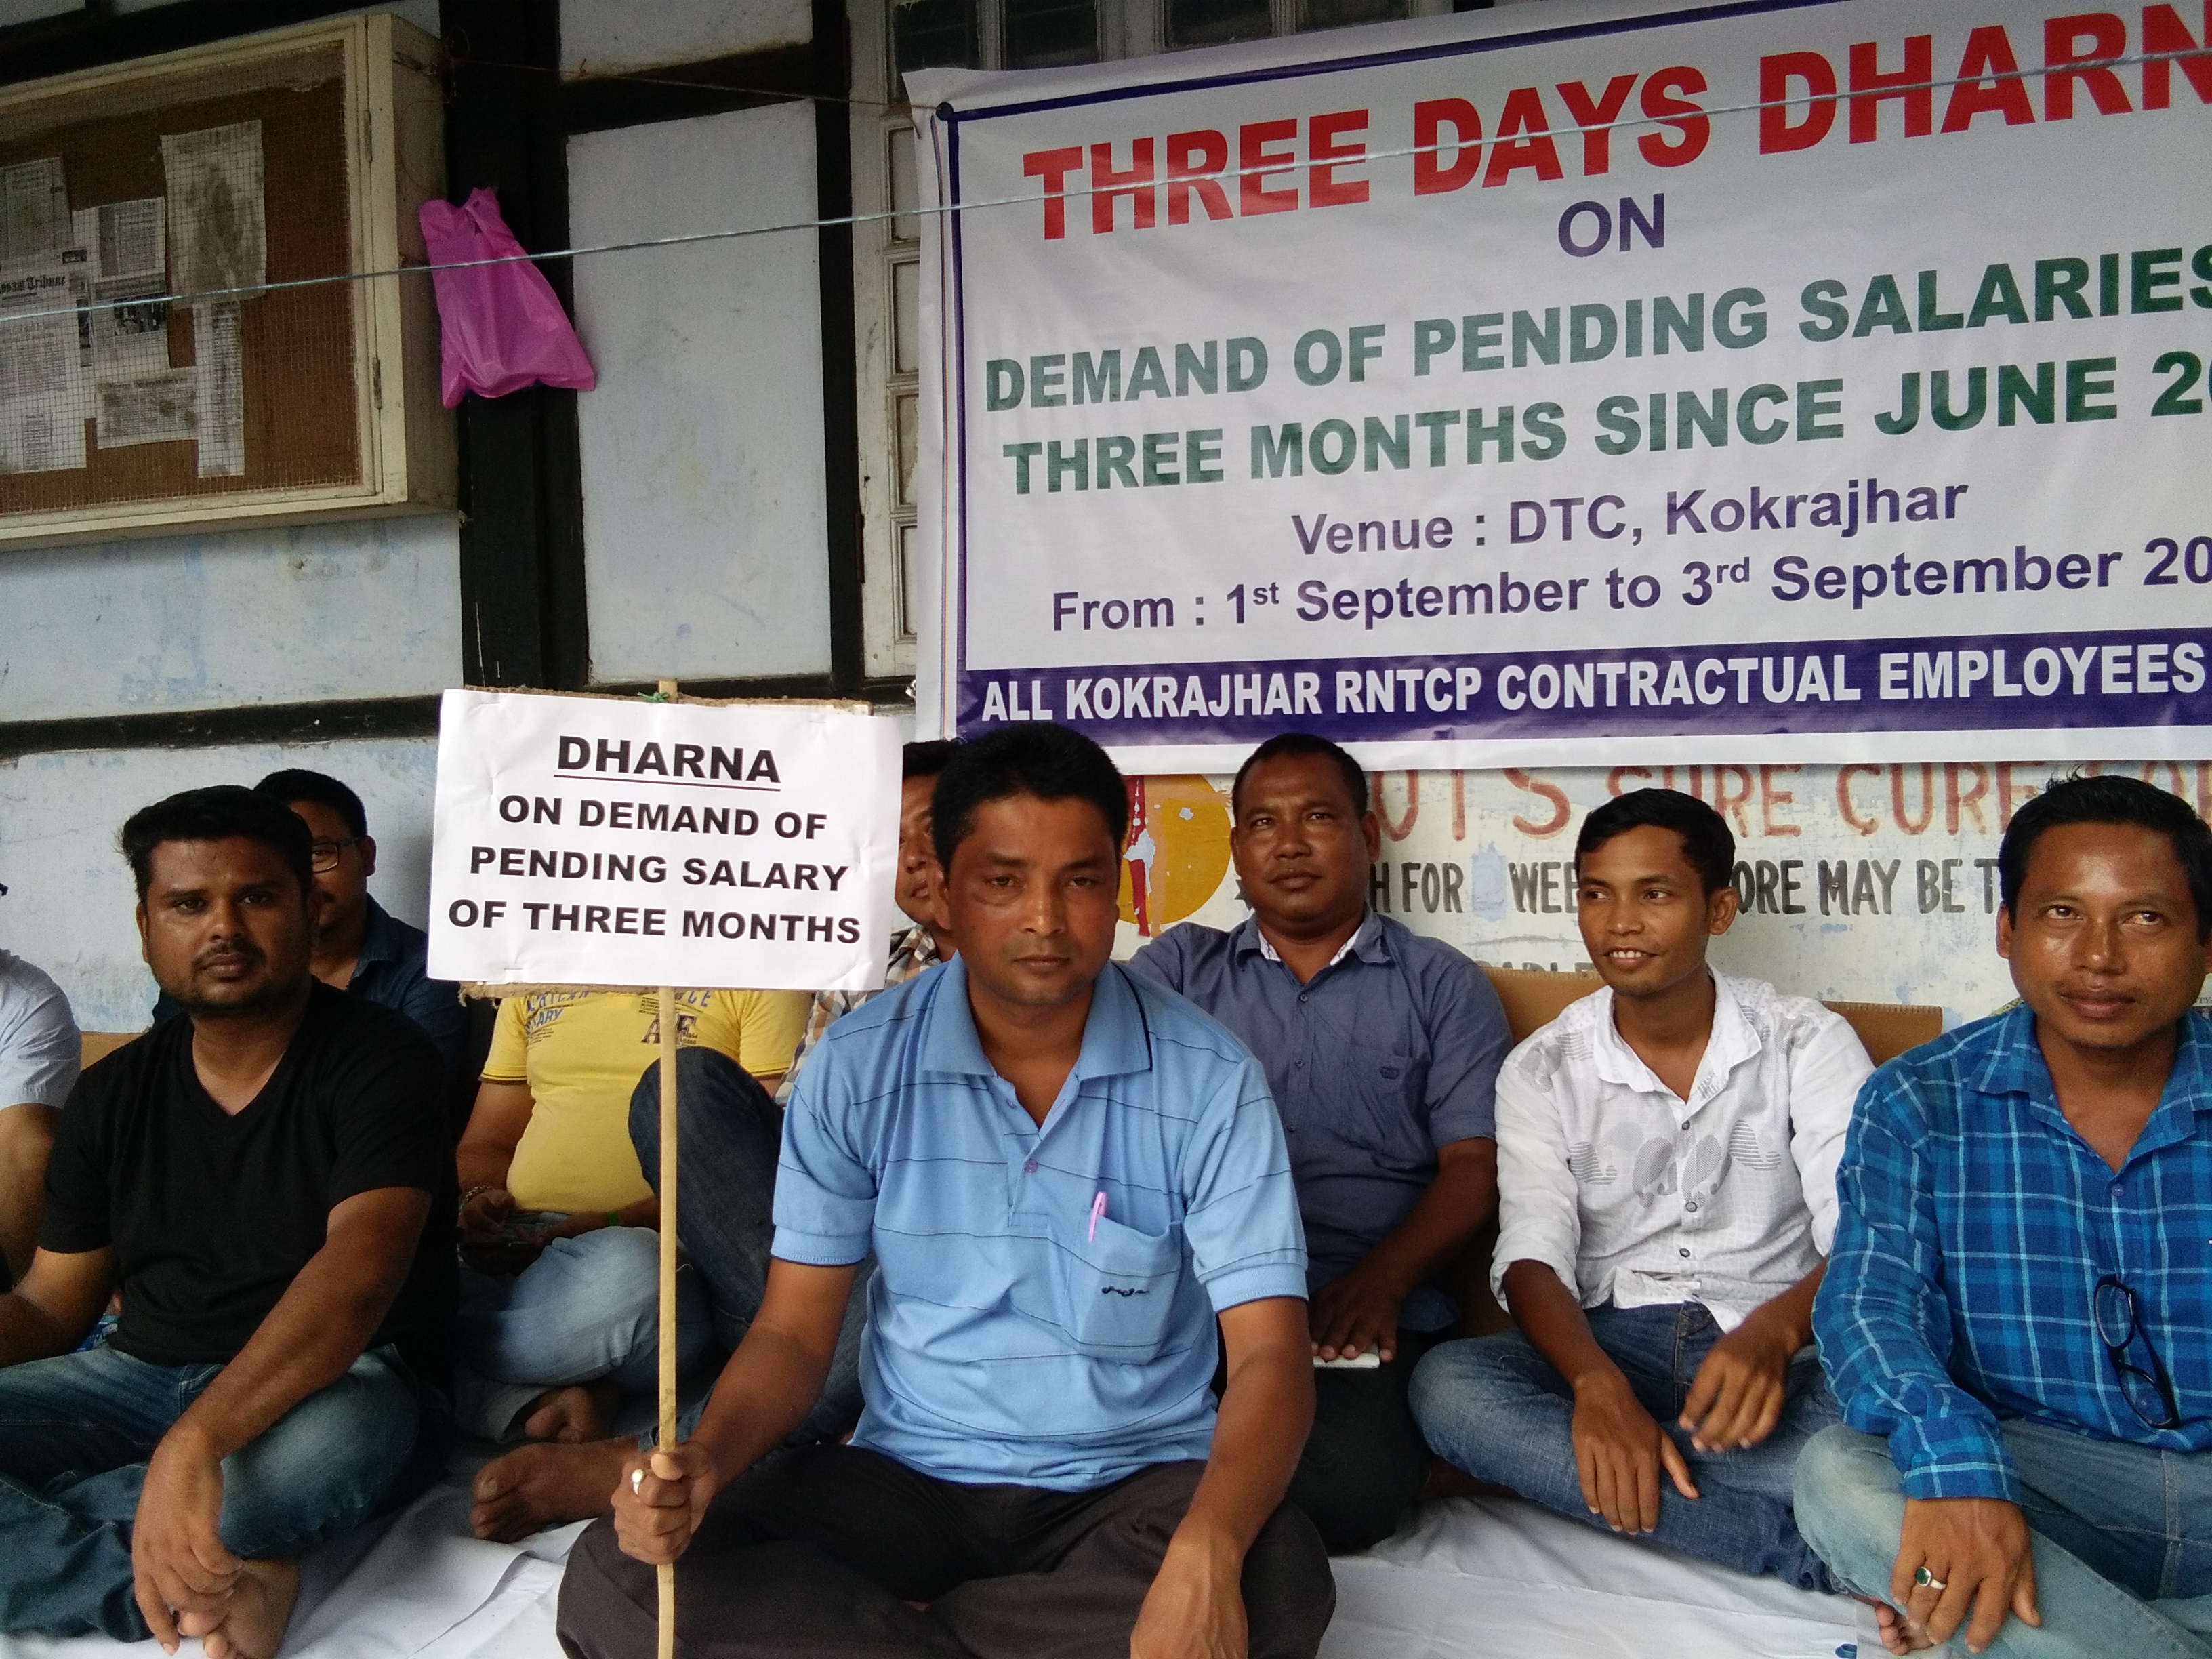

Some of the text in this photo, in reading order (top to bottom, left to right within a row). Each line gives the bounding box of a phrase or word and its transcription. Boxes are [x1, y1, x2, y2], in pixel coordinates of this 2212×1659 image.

[1023, 108, 1370, 240] THREE
[1414, 66, 1711, 196] DAYS
[1557, 192, 1665, 258] ON
[986, 337, 1269, 412] DEMAND
[1294, 325, 1385, 385] OF
[1414, 287, 1767, 377] PENDING
[1003, 350, 2212, 495] THREE MONTHS SINCE JUNE 2
[1291, 513, 1453, 555] Venue
[1509, 495, 1643, 546] DTC,
[1666, 478, 1969, 537] Kokrajhar
[1052, 592, 1174, 632] From
[1227, 581, 1280, 624] 1st
[1296, 571, 1589, 630] September
[1605, 567, 1661, 609] to
[1681, 556, 1750, 606] 3rd
[1771, 545, 2123, 610] September
[982, 642, 2205, 722] ALL KOKRAJHAR RNTCP CONTRACTUAL EMPLOYEES
[556, 735, 781, 784] DHARNA
[499, 795, 827, 839] ON DEMAND OF
[470, 846, 848, 892] PENDING SALARY
[1400, 862, 1463, 913] FOR
[1508, 861, 1579, 915] WEE
[1730, 859, 1807, 915] ORE
[1818, 859, 1901, 916] MAY
[1916, 858, 1965, 915] BE
[449, 899, 861, 943] OF THREE MONTHS
